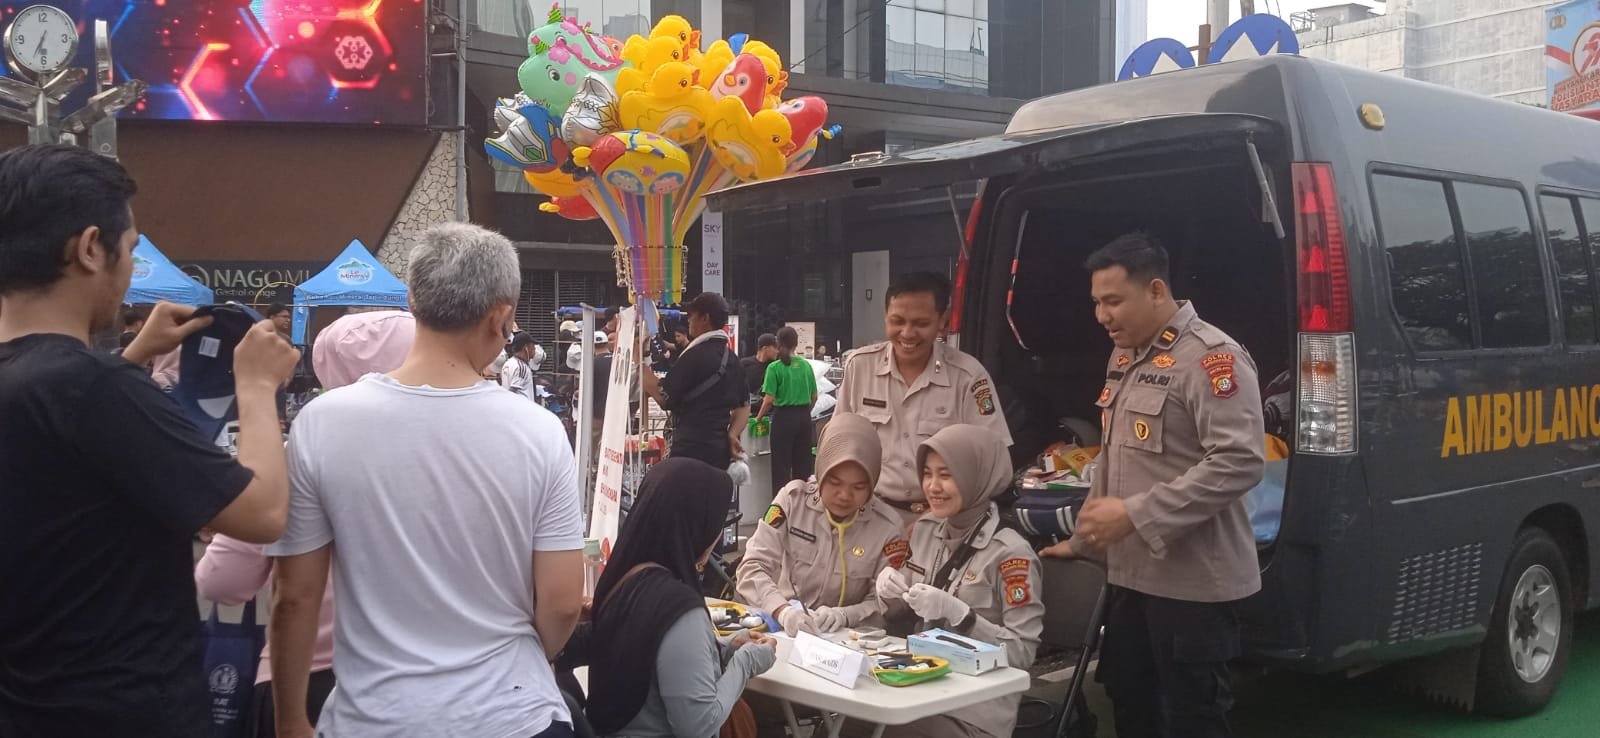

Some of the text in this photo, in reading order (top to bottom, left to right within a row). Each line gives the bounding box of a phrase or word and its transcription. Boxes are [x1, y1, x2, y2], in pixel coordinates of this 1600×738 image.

[39, 13, 48, 22] 12
[18, 35, 24, 44] 9
[61, 34, 67, 43] 3
[41, 56, 47, 65] 6
[704, 225, 720, 233] SKY
[214, 269, 309, 288] NAGOMI
[1138, 373, 1171, 386] POLRI
